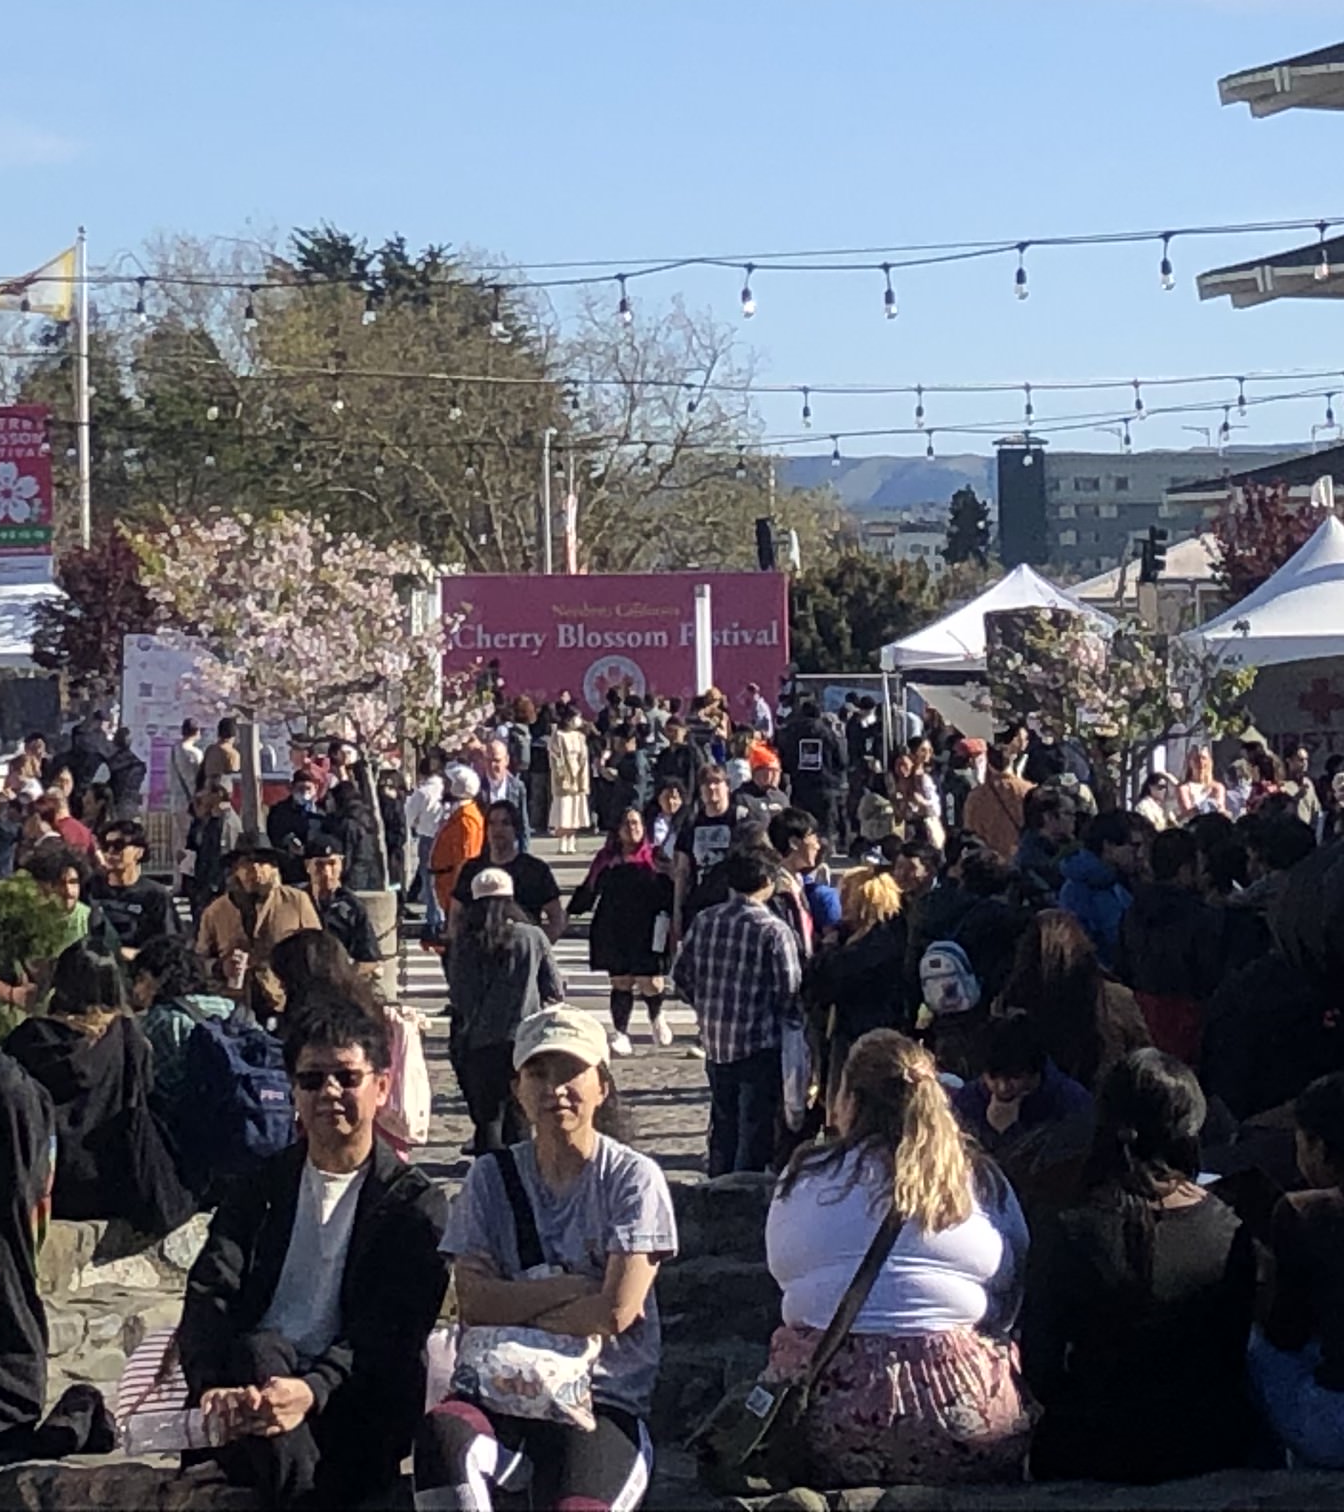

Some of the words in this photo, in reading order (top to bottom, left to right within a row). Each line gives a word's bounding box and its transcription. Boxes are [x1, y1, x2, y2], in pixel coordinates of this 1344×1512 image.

[455, 623, 547, 656] Cherry
[557, 623, 668, 649] Blossom
[679, 620, 779, 647] Fstival
